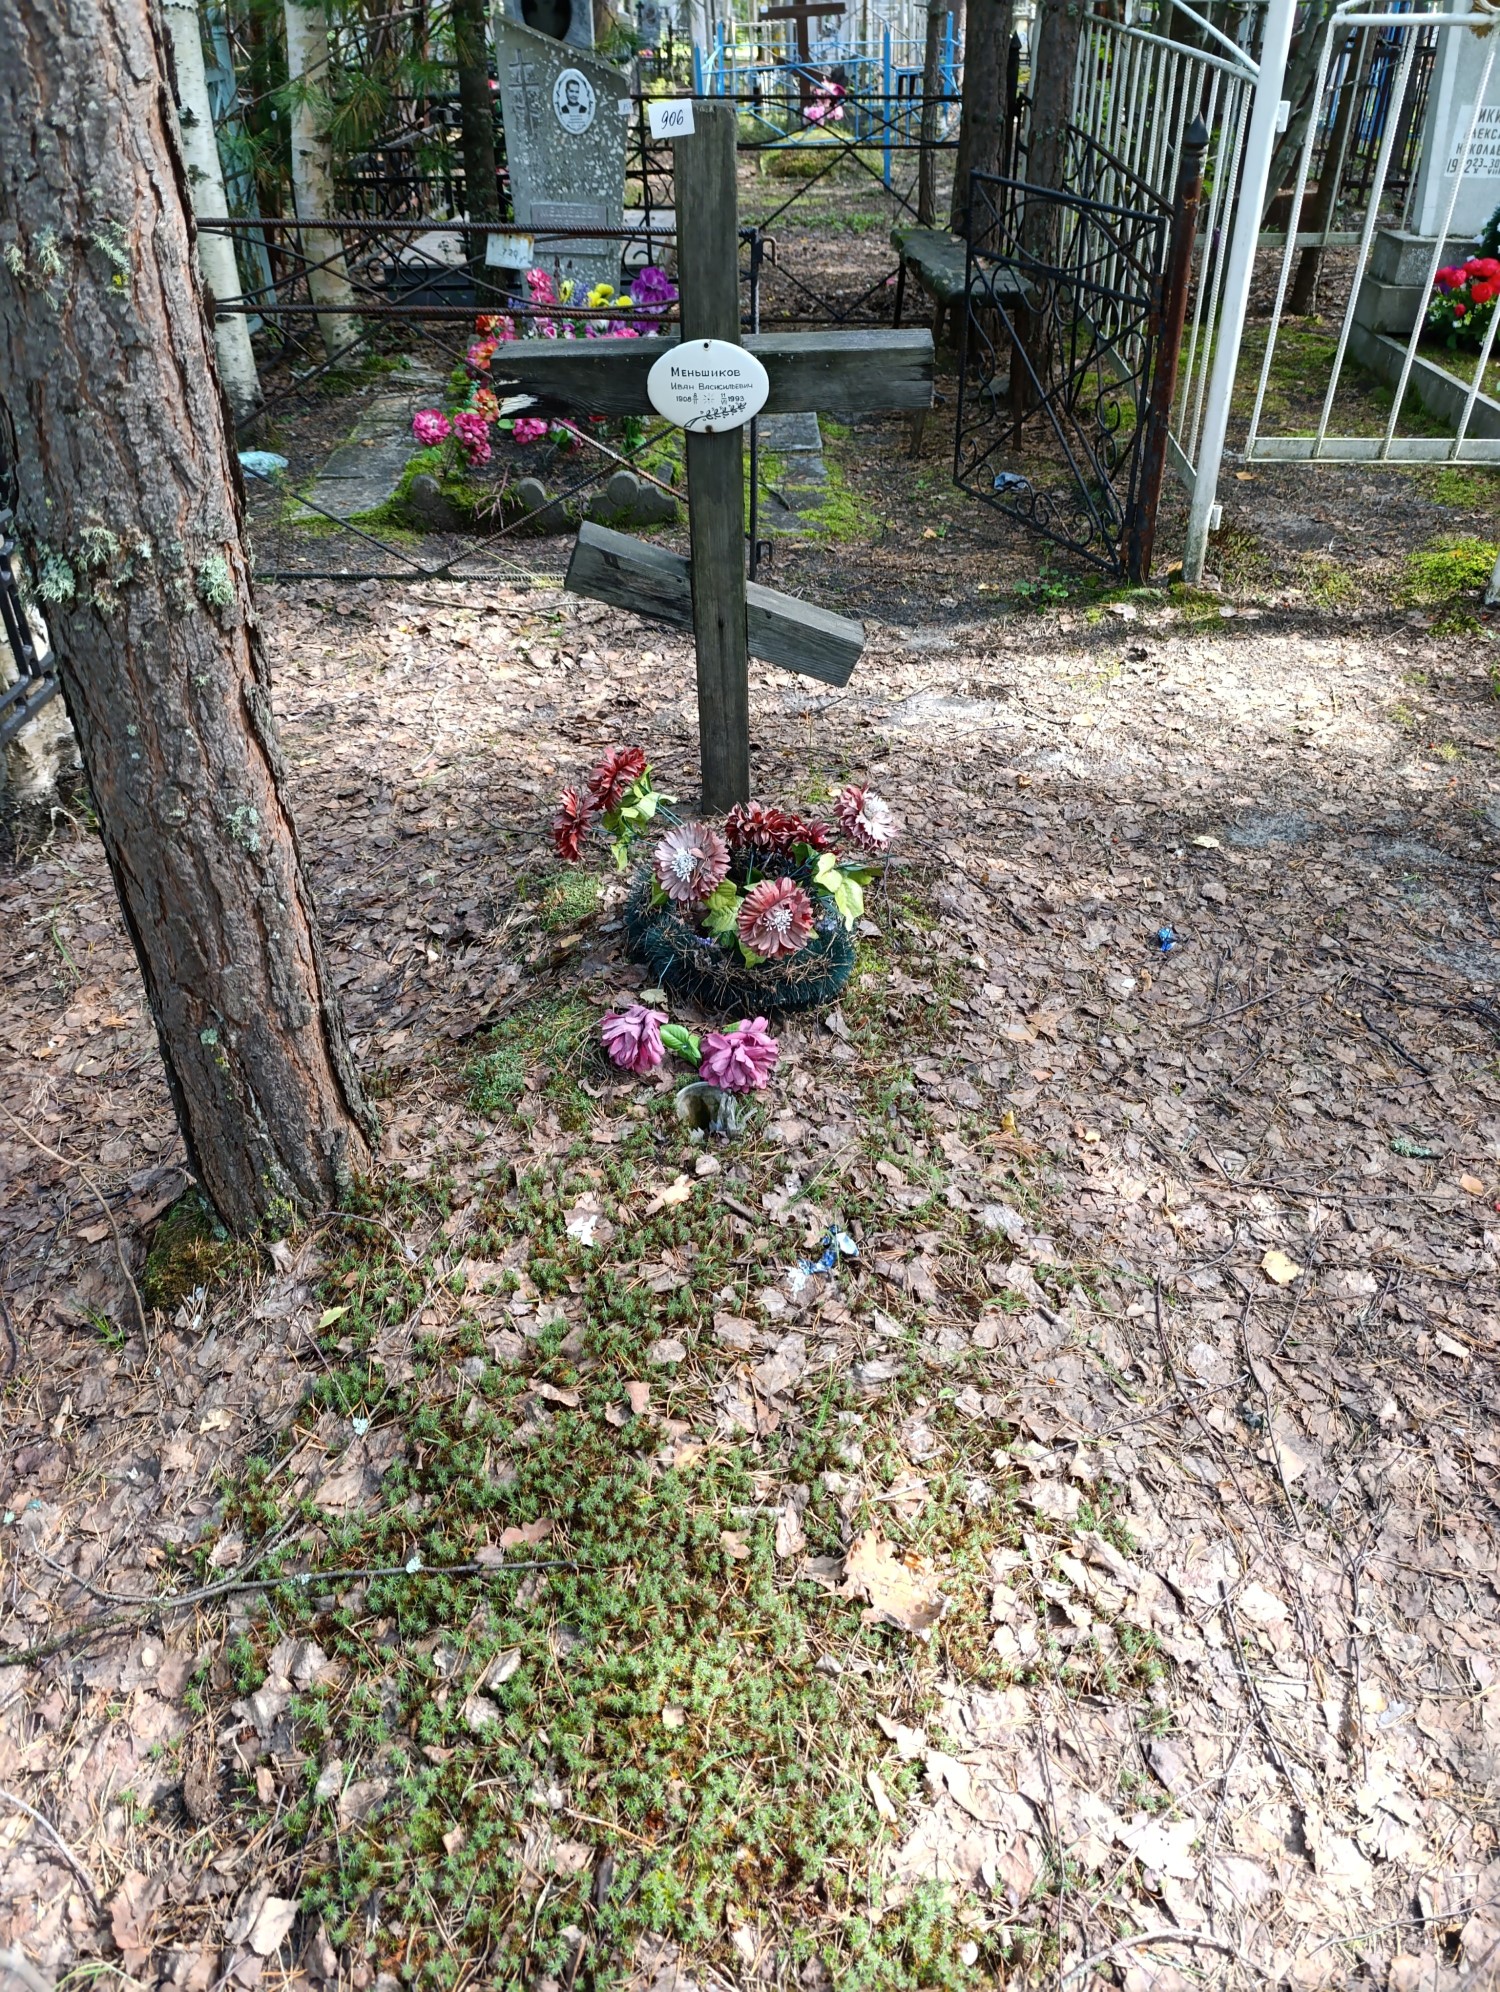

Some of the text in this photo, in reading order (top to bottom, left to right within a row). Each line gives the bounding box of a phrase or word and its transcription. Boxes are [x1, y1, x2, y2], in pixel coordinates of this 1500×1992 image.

[661, 109, 684, 130] 906
[1446, 158, 1473, 174] 192
[676, 395, 692, 403] 1908
[727, 395, 745, 403] 1993
